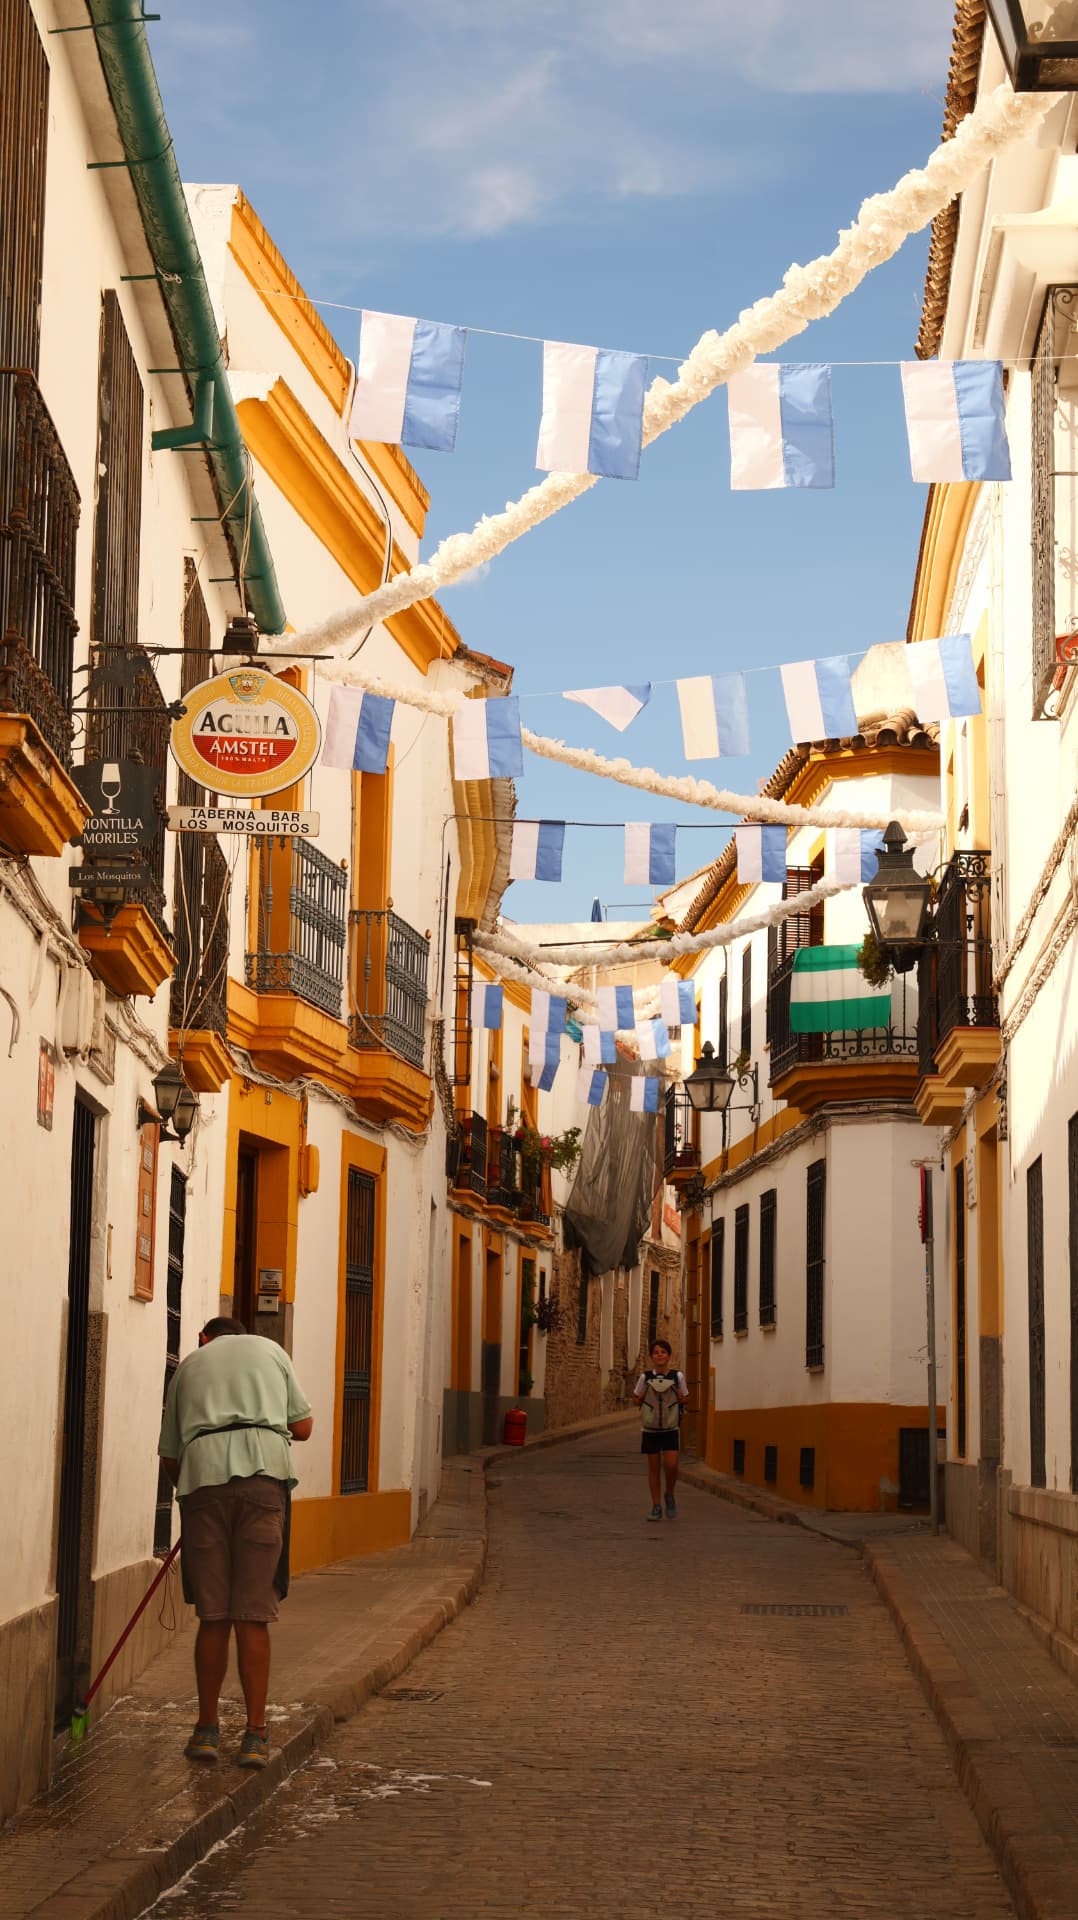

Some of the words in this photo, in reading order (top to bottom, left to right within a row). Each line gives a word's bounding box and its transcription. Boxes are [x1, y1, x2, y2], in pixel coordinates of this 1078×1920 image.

[209, 740, 278, 756] AMSTEL
[190, 808, 256, 821] TABERNA
[271, 811, 300, 822] BAR
[179, 819, 208, 830] LOS
[222, 820, 310, 834] MOSQUITOS
[83, 832, 139, 844] MORILES
[78, 872, 95, 881] Los
[97, 871, 142, 883] Mosquitos
